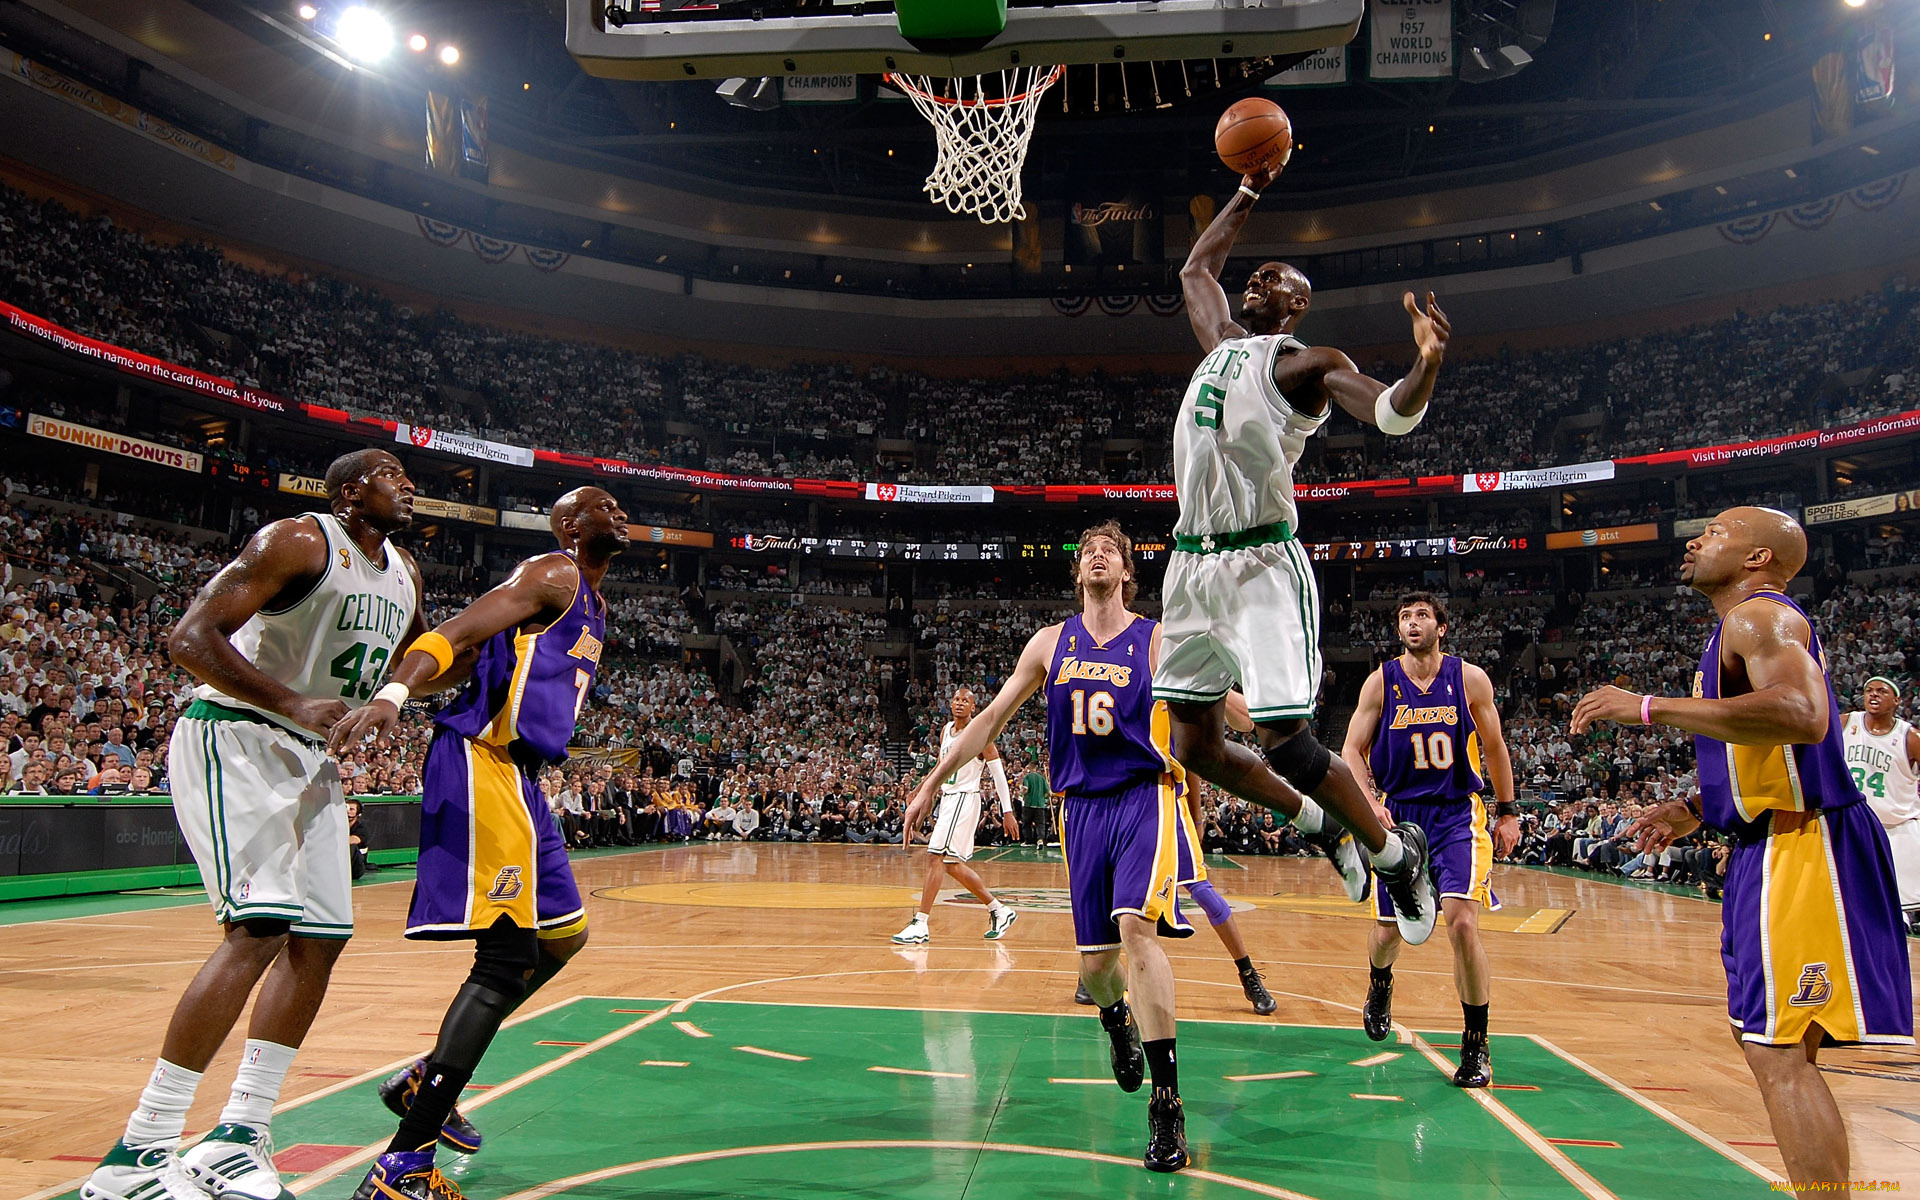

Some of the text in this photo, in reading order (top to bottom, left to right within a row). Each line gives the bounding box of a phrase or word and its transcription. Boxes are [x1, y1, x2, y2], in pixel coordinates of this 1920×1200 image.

[1400, 22, 1424, 34] 1957
[1390, 37, 1433, 49] WORLD
[1376, 52, 1447, 65] CHAMPIONS
[787, 75, 852, 89] CHAMPIONS
[1082, 202, 1153, 224] The Finals
[10, 312, 285, 412] The most important name on the card isn't ours. It's yours.
[1194, 383, 1227, 431] 5
[45, 422, 183, 467] DUNKIN' DONUTS
[435, 431, 510, 462] Harvard Pilgrim
[1692, 415, 1920, 463] Visit harvardpilgrim.org for more informati
[602, 463, 793, 491] Visit harvardpilgrim.org for more information.
[1503, 469, 1587, 485] Harvard Pilgrim
[900, 487, 938, 499] Harvard
[938, 490, 971, 502] Pilgrim
[1103, 488, 1124, 498] You
[1125, 488, 1154, 498] don't
[1155, 490, 1174, 498] see
[1311, 486, 1350, 497] doctor.
[1807, 503, 1846, 516] SPORTS
[1834, 509, 1860, 520] DESK
[666, 532, 683, 541] at&t
[730, 537, 745, 548] 15
[761, 534, 797, 551] Finals
[1400, 539, 1416, 547] AST
[1426, 538, 1444, 546] REB
[1465, 536, 1508, 551] Finals
[1511, 538, 1527, 550] 15
[1600, 532, 1620, 541] at&t
[851, 540, 866, 548] STL
[906, 543, 921, 551] 3PT
[946, 543, 958, 551] FG
[1134, 543, 1166, 551] LAKERS
[1378, 550, 1384, 558] 2
[1404, 548, 1411, 557] 4
[1432, 547, 1438, 555] 2
[879, 550, 885, 558] 3
[1143, 551, 1155, 560] 10
[337, 593, 405, 645] CELTICS
[330, 641, 389, 701] 43
[1054, 656, 1133, 687] LAKERS
[574, 668, 591, 722] 7
[1071, 689, 1115, 736] 16
[1389, 704, 1458, 729] LAKERS
[1410, 731, 1454, 770] 10
[1847, 744, 1892, 772] CELTICS
[1850, 766, 1885, 798] 34
[117, 828, 138, 844] abc
